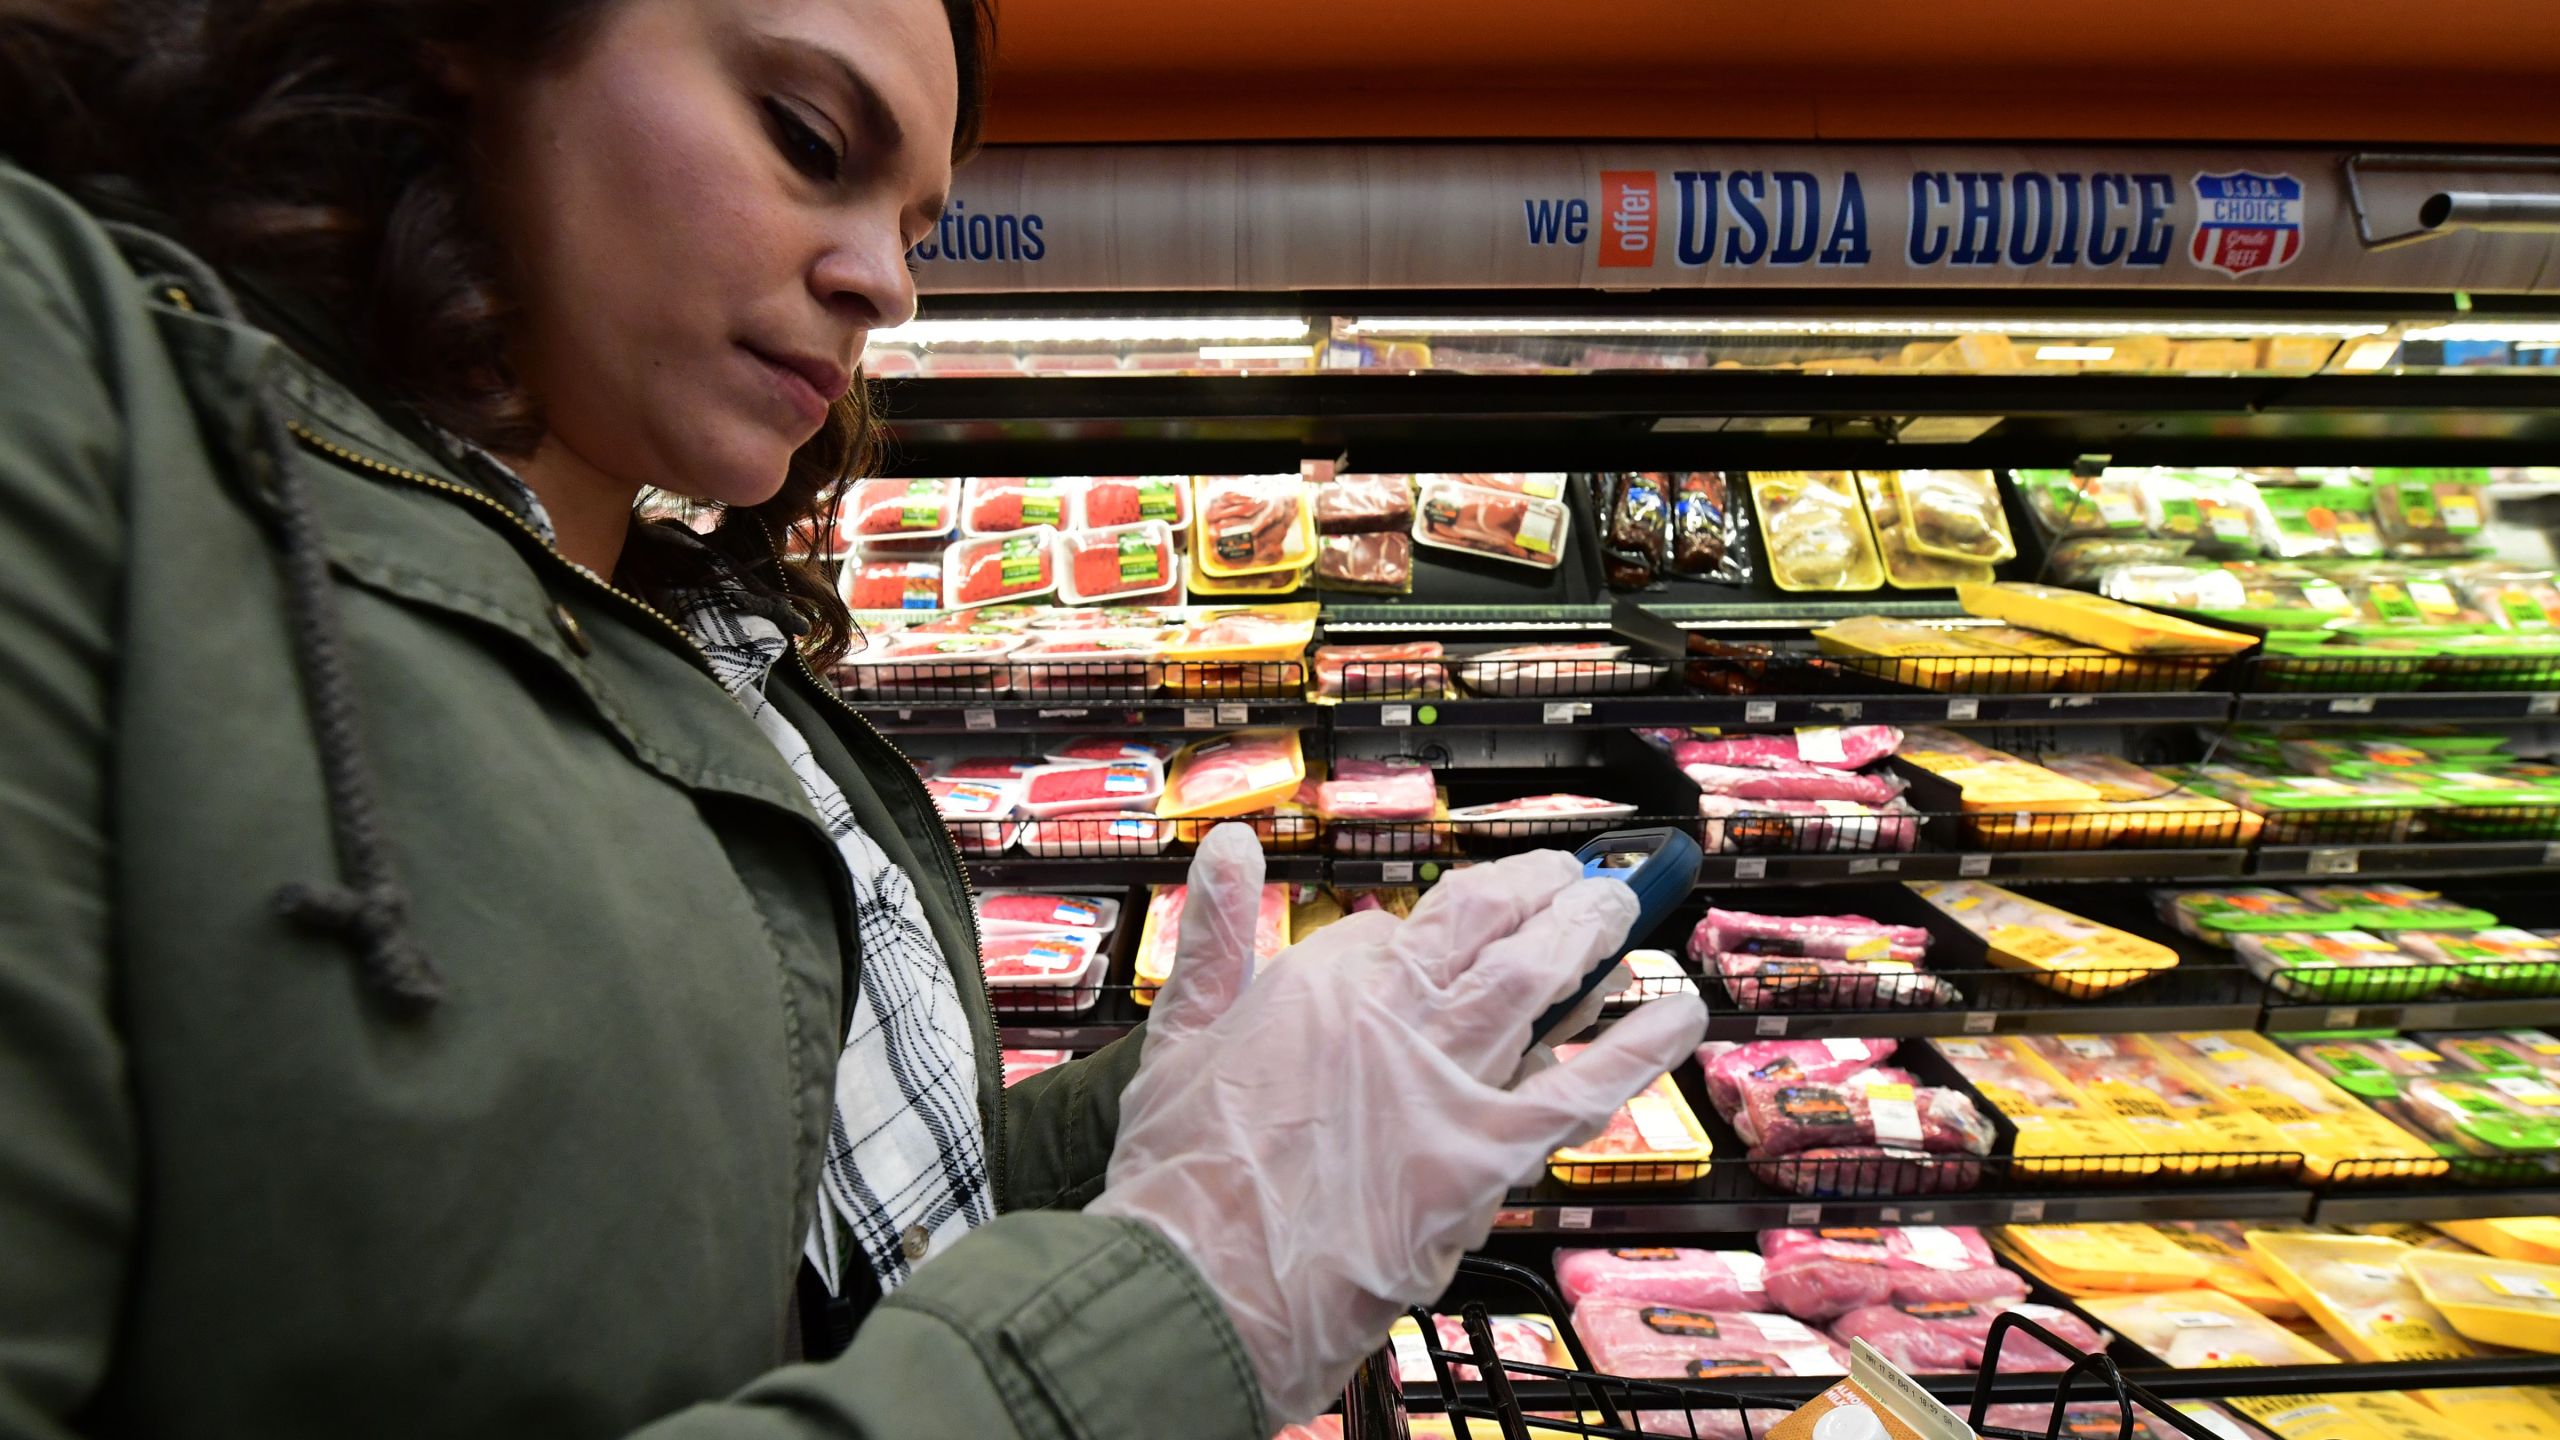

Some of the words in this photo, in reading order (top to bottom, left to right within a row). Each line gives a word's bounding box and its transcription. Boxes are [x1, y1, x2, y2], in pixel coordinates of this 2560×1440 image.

[1524, 198, 1589, 245] we
[1612, 184, 1650, 252] offer
[1672, 170, 1872, 267] USDA
[1906, 170, 2176, 267] CHOICE
[2214, 200, 2288, 221] CHOICE
[2225, 249, 2259, 267] BEEF
